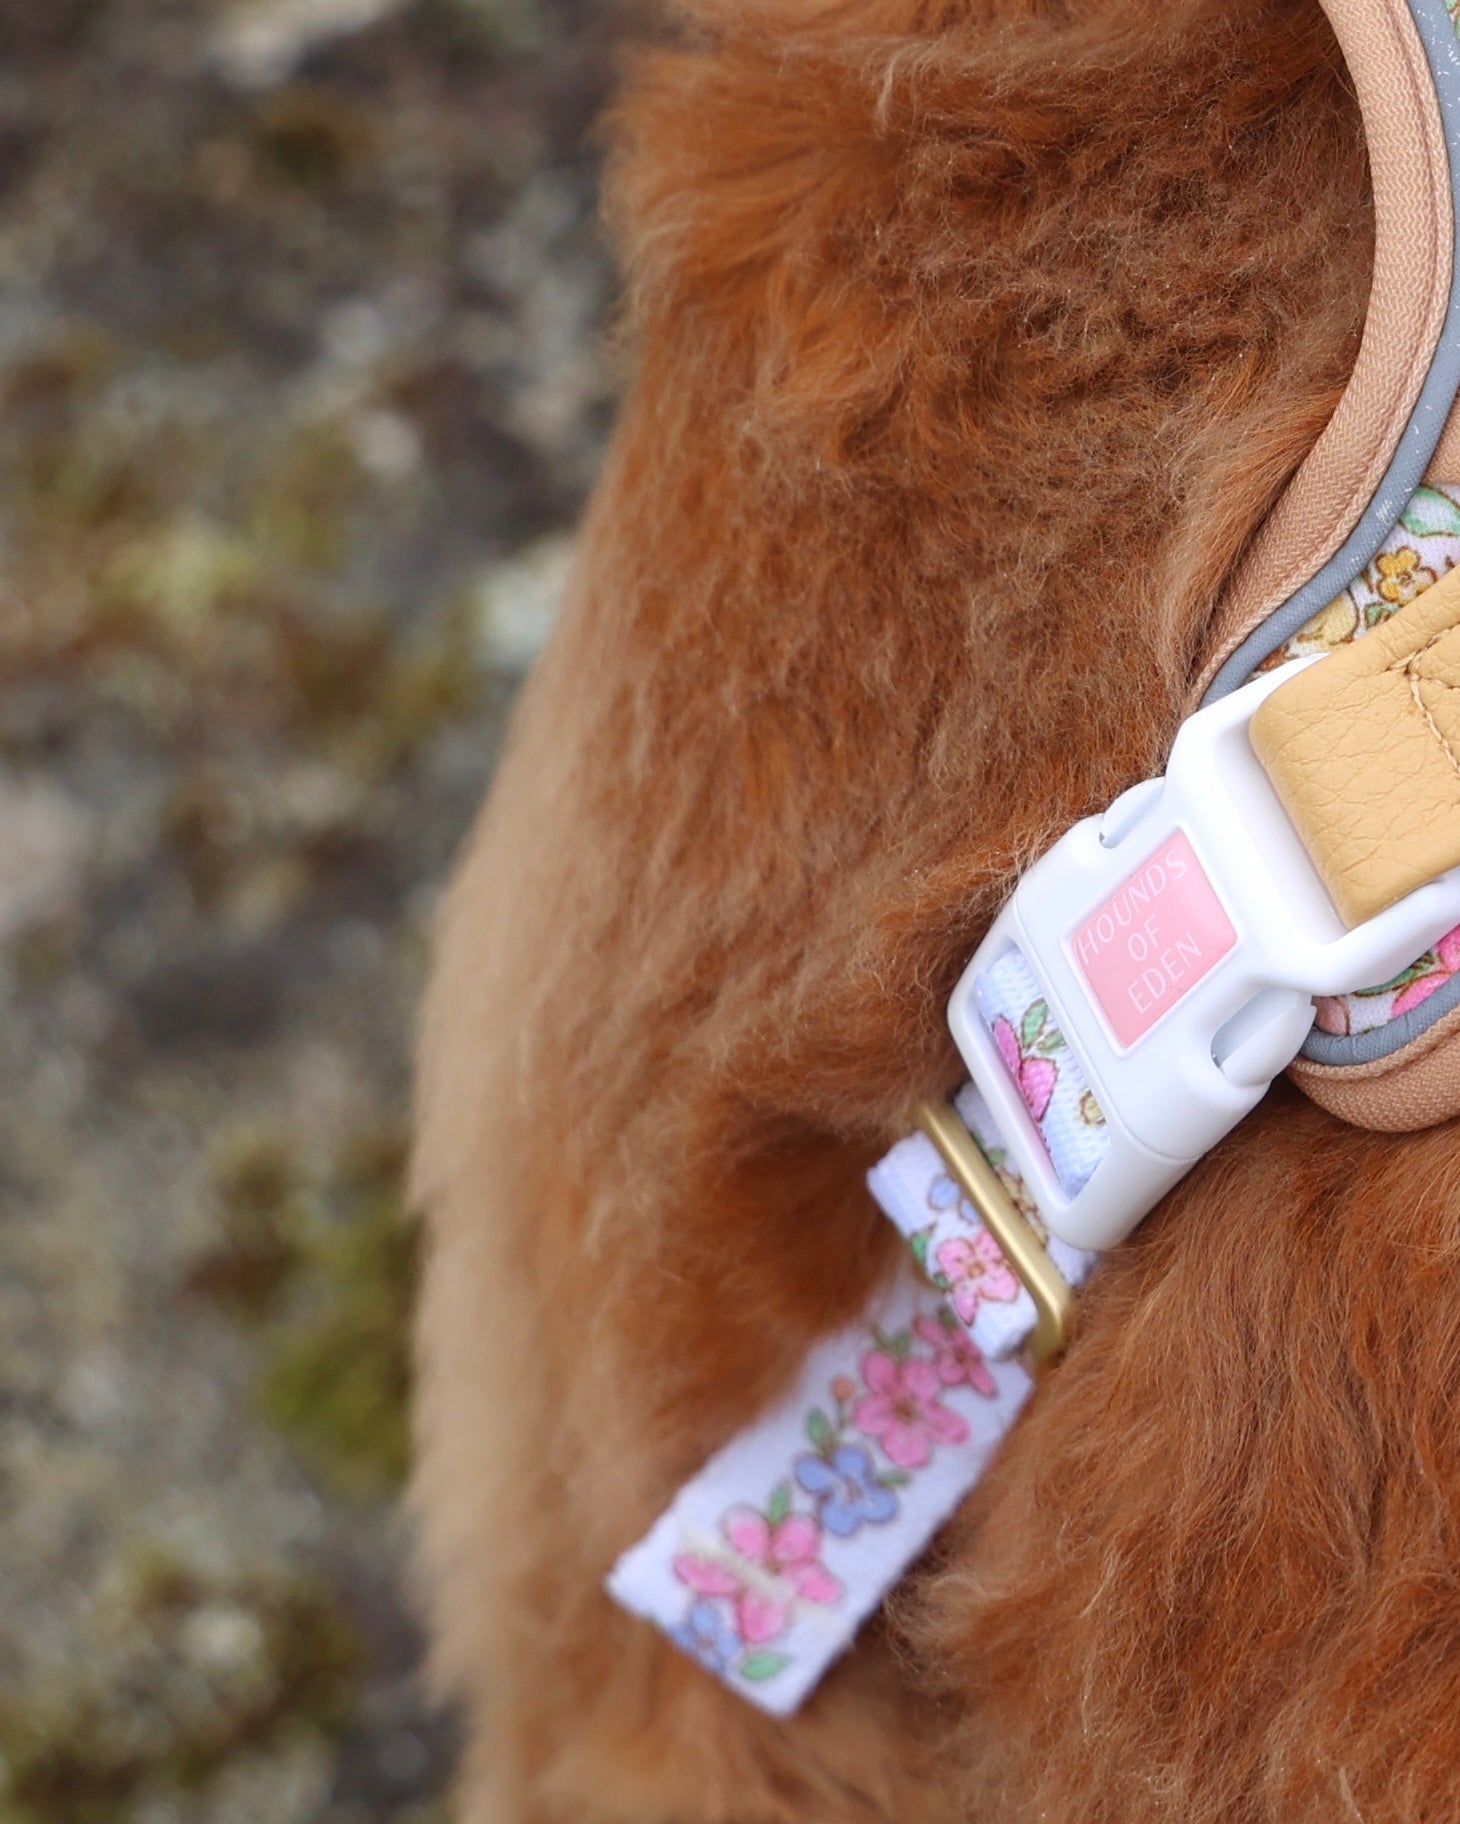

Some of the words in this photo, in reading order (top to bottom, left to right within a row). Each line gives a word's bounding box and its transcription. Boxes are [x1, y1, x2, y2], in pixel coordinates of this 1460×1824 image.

[1076, 849, 1187, 965] HOUNDS
[1127, 915, 1162, 962] OF
[1127, 933, 1202, 1014] EDEN
